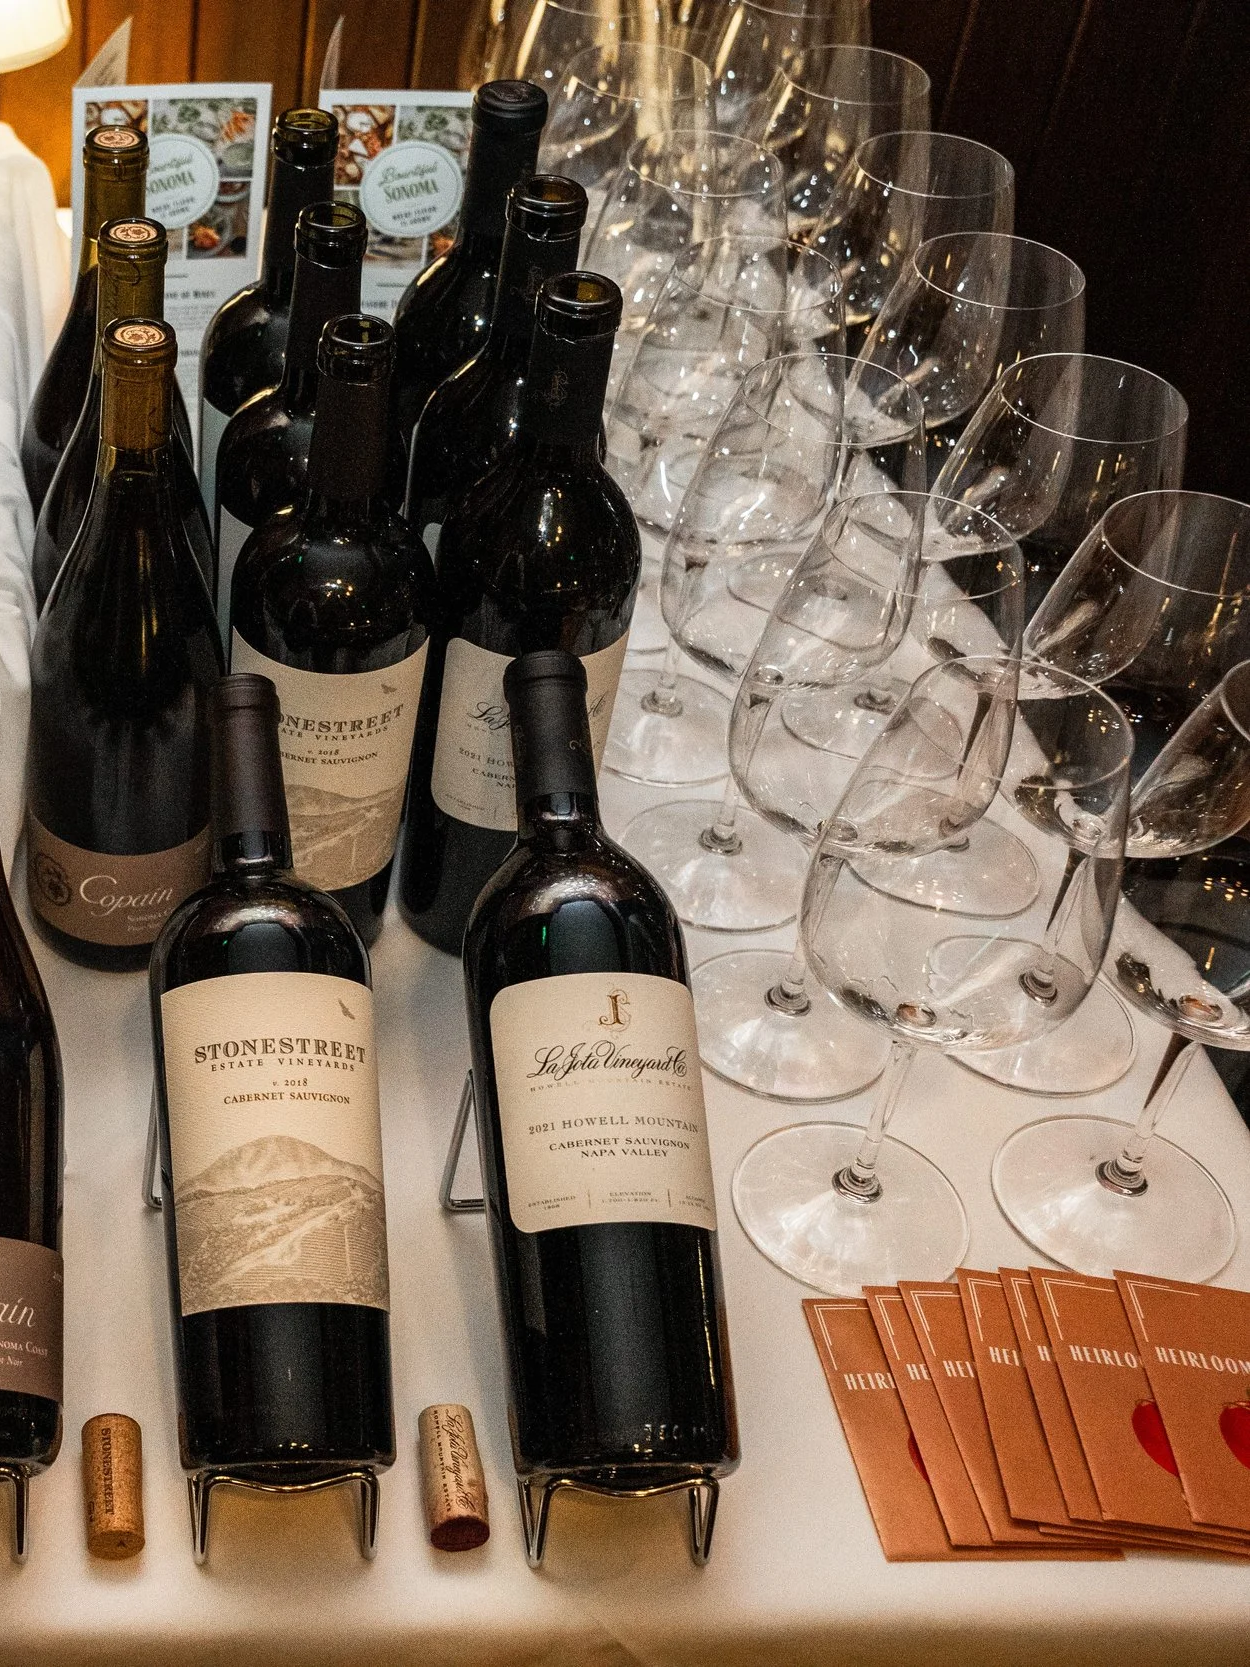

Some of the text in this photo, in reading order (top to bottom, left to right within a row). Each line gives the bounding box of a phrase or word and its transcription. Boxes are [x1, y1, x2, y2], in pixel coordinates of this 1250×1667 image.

[147, 171, 195, 194] ONOMA
[384, 179, 439, 204] SONOMA
[315, 725, 388, 741] VINEYARDS
[321, 751, 378, 765] SAUVIGNON
[80, 874, 173, 917] Copain
[194, 1037, 366, 1064] STONESTREET
[211, 1058, 355, 1072] ESTATE VINEYARDS
[526, 1045, 565, 1079] La
[591, 1040, 675, 1079] Vineyard
[284, 1078, 308, 1087] 2018
[223, 1092, 350, 1105] CABERNET SAUVIGNON
[528, 1116, 699, 1135] 2021 HOWELL MOUNTAIN
[549, 1137, 690, 1151] CABERNET SAUVIGNON
[581, 1148, 668, 1158] NAPA VALLEY
[1068, 1344, 1143, 1369] HEIRLO
